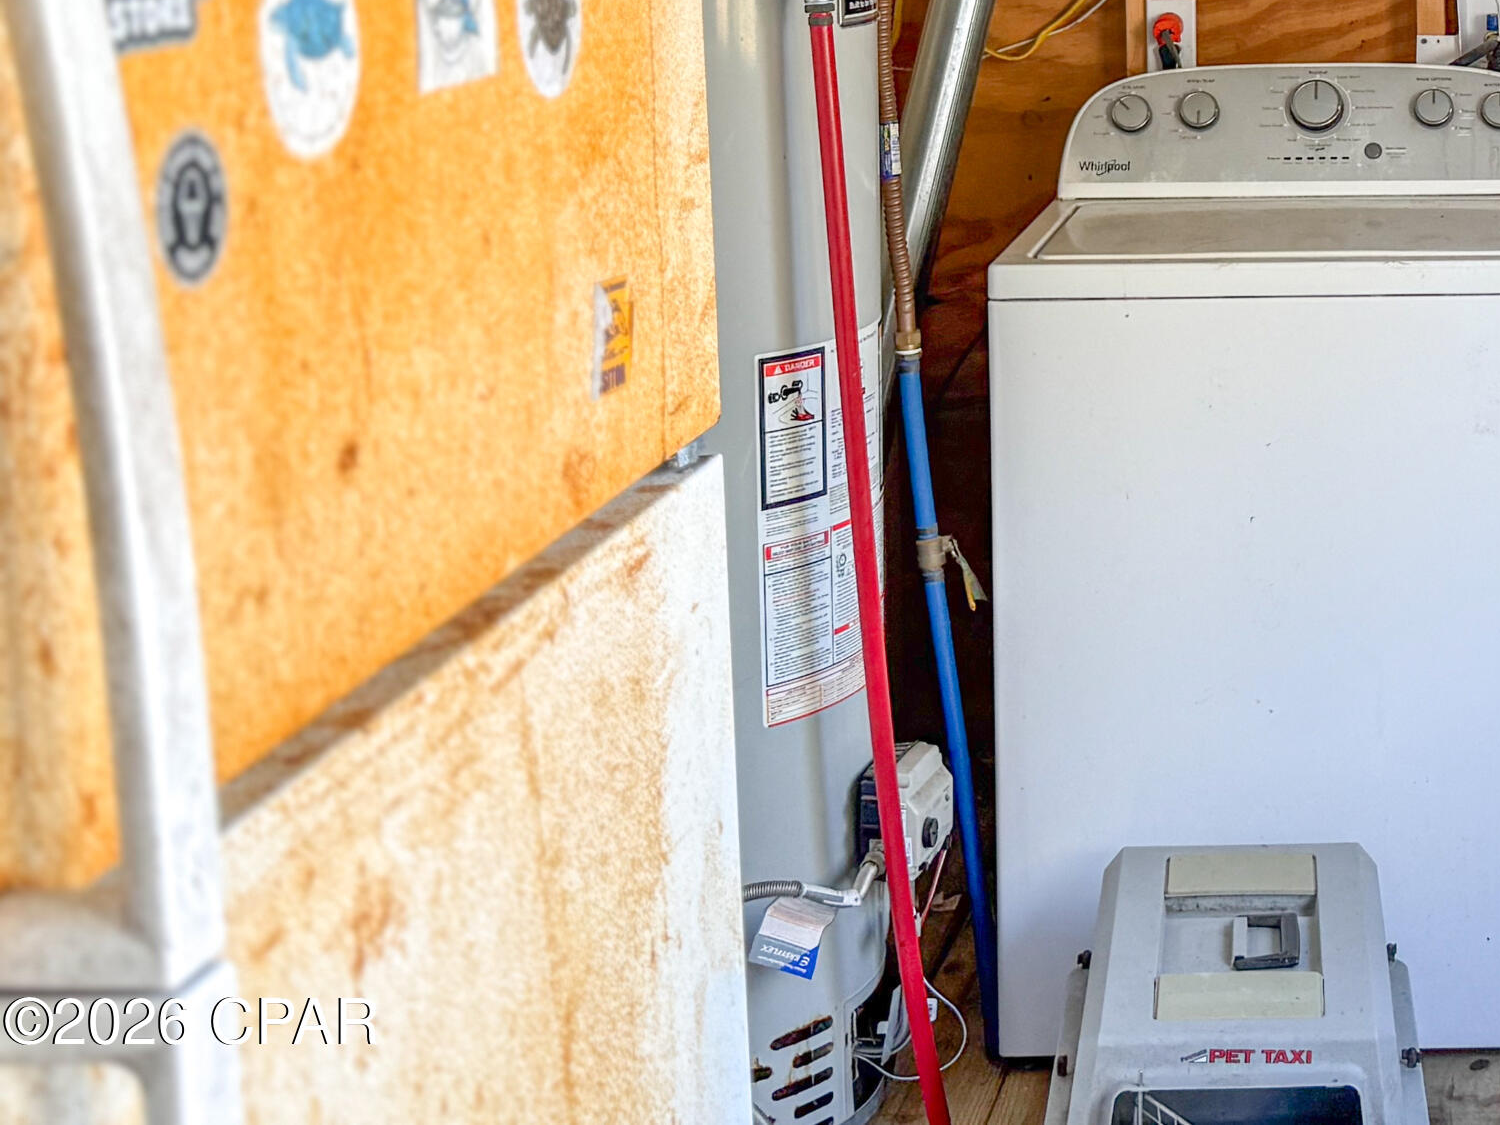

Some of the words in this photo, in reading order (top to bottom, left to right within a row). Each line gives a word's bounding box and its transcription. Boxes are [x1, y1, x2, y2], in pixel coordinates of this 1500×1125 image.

[1079, 159, 1131, 176] Whirlpool
[784, 359, 815, 372] DANGER
[1209, 1048, 1255, 1064] PET
[1261, 1049, 1313, 1064] TAXI
